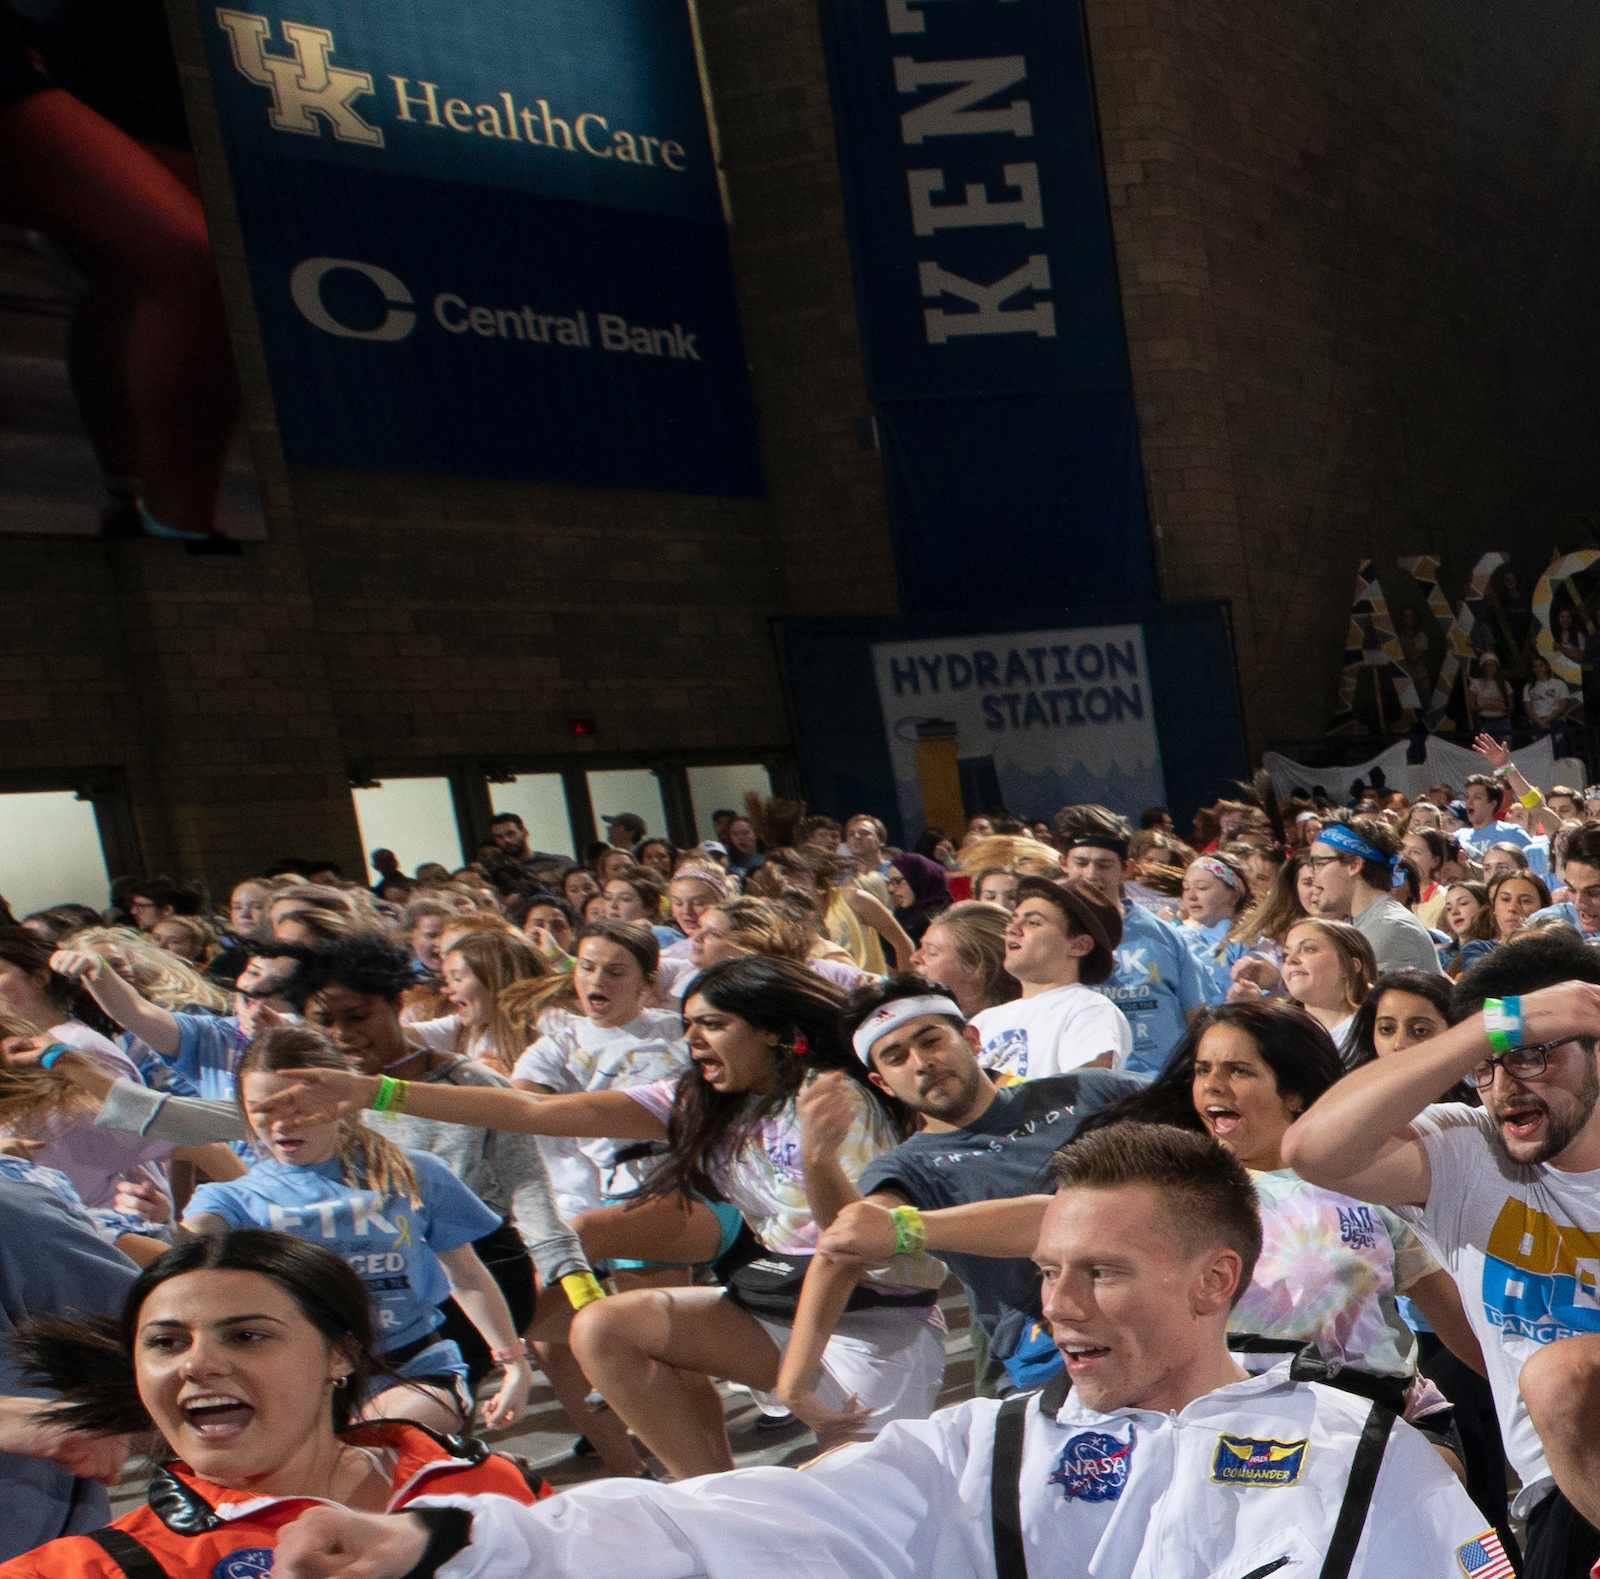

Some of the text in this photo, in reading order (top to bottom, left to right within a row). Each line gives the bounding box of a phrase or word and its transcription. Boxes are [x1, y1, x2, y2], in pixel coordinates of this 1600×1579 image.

[217, 7, 687, 172] UK HealthCare
[434, 292, 591, 350] Central
[601, 314, 702, 363] Bank
[889, 640, 1137, 697] HYDRATION
[981, 684, 1143, 733] STATION
[1063, 1456, 1127, 1477] NASA
[1222, 1466, 1291, 1480] COMMANDER
